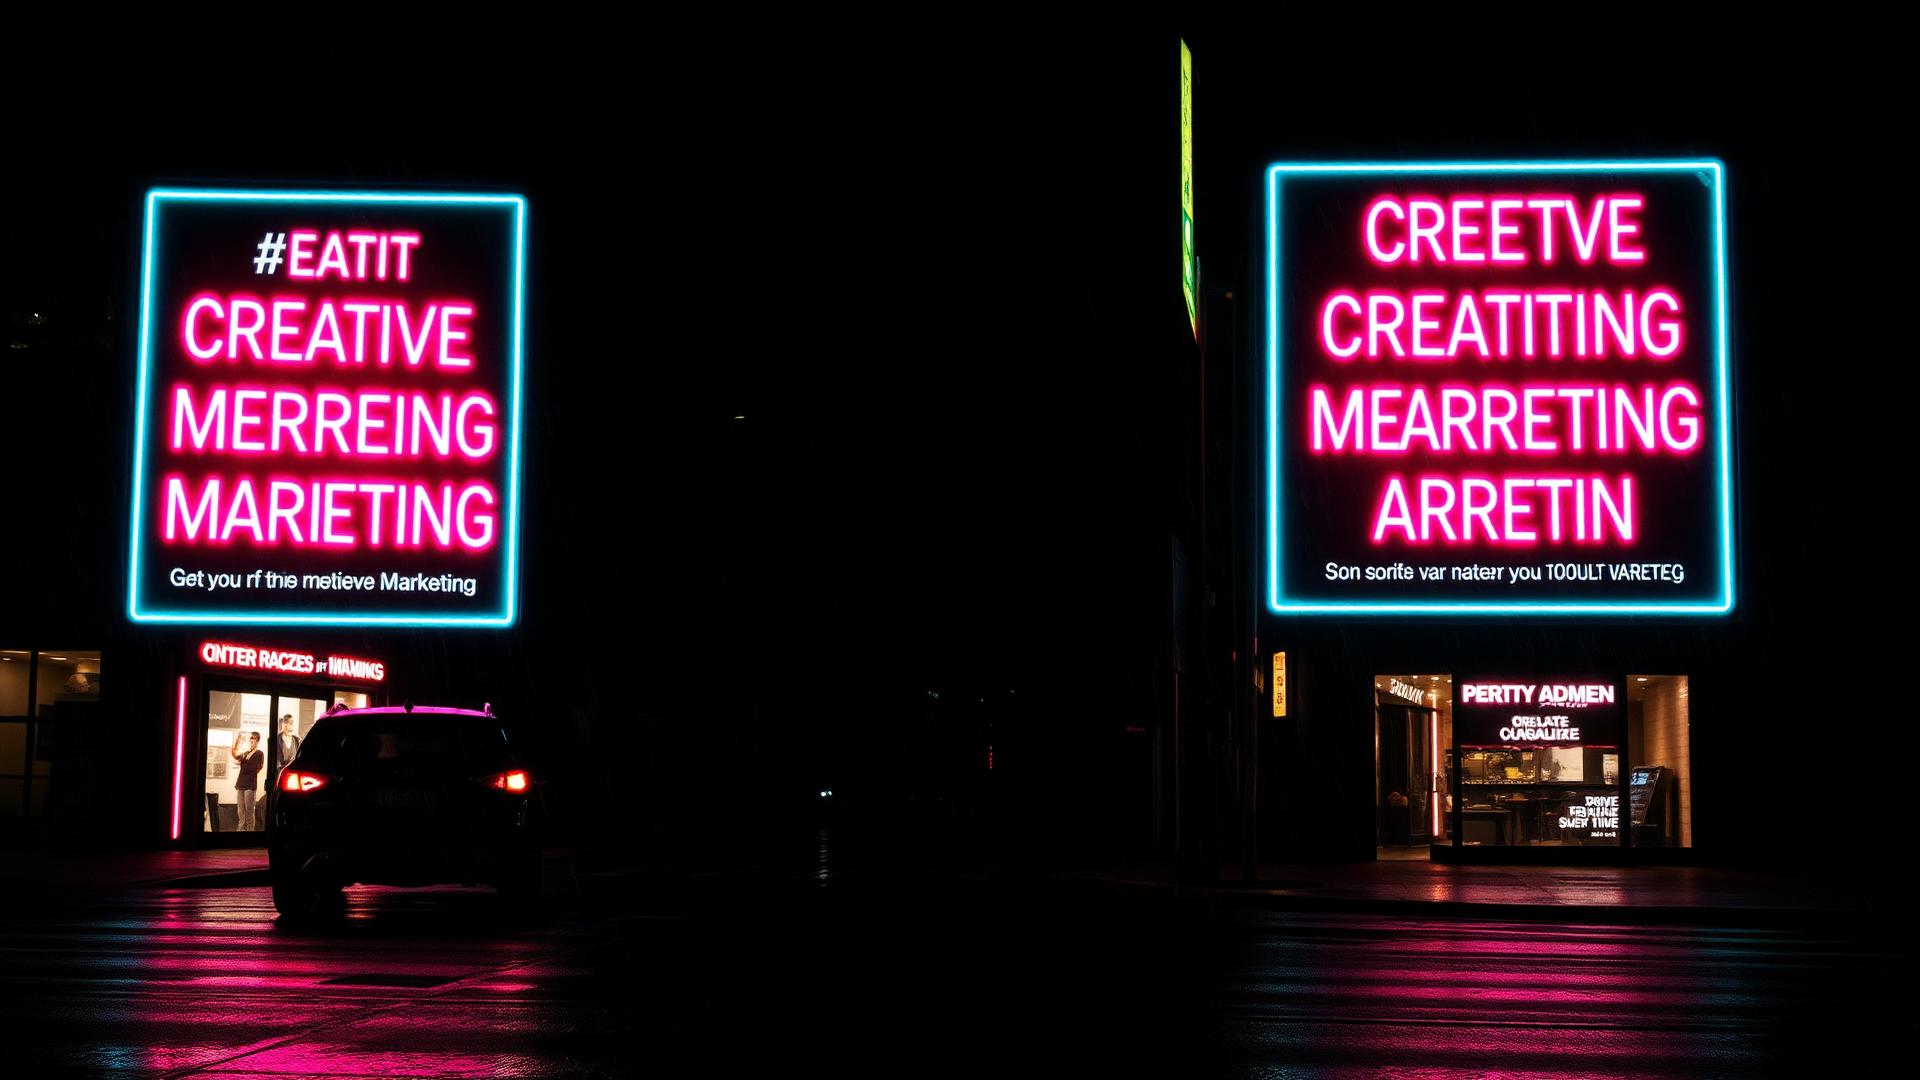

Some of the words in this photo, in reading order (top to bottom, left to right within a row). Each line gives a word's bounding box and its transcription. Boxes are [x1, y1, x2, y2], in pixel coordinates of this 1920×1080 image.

[252, 231, 420, 280] #EATIT
[1364, 197, 1645, 265] CREETVE
[183, 296, 474, 368] CREATIVE
[1321, 290, 1681, 359] CREATITING
[172, 387, 495, 459] MERREING
[1311, 385, 1700, 452] MEARRETING
[164, 477, 494, 549] MARIETING
[1372, 476, 1634, 542] ARRETIN
[169, 568, 204, 588] Get
[207, 572, 241, 591] you
[380, 572, 477, 597] Marketing
[1325, 562, 1361, 580] Son
[1419, 566, 1447, 580] var
[1508, 567, 1542, 584] you
[1538, 685, 1615, 703] ADMEN
